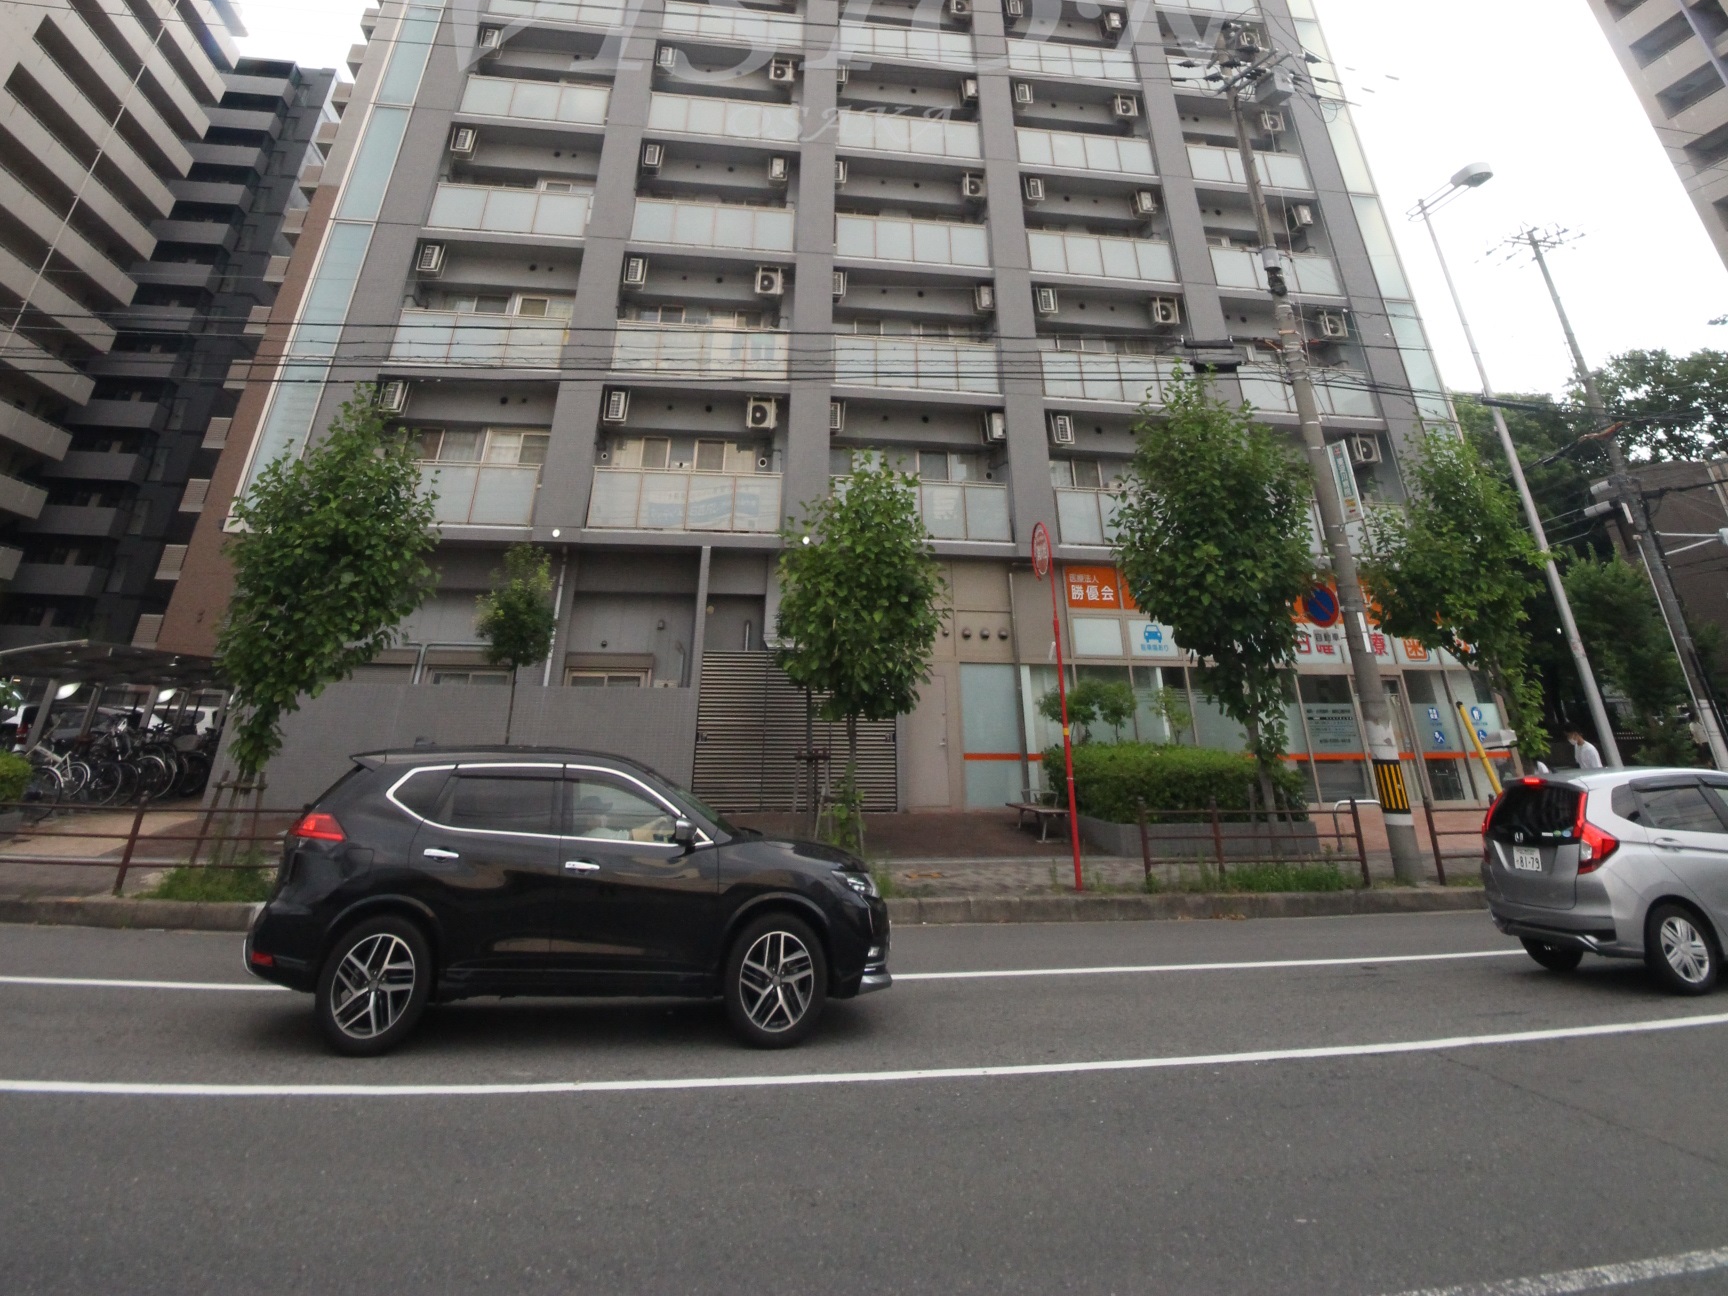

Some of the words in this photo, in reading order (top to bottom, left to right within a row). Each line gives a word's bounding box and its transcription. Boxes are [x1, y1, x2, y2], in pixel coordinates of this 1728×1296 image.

[1069, 573, 1099, 583] 医療法人
[1071, 585, 1114, 601] 勝優会
